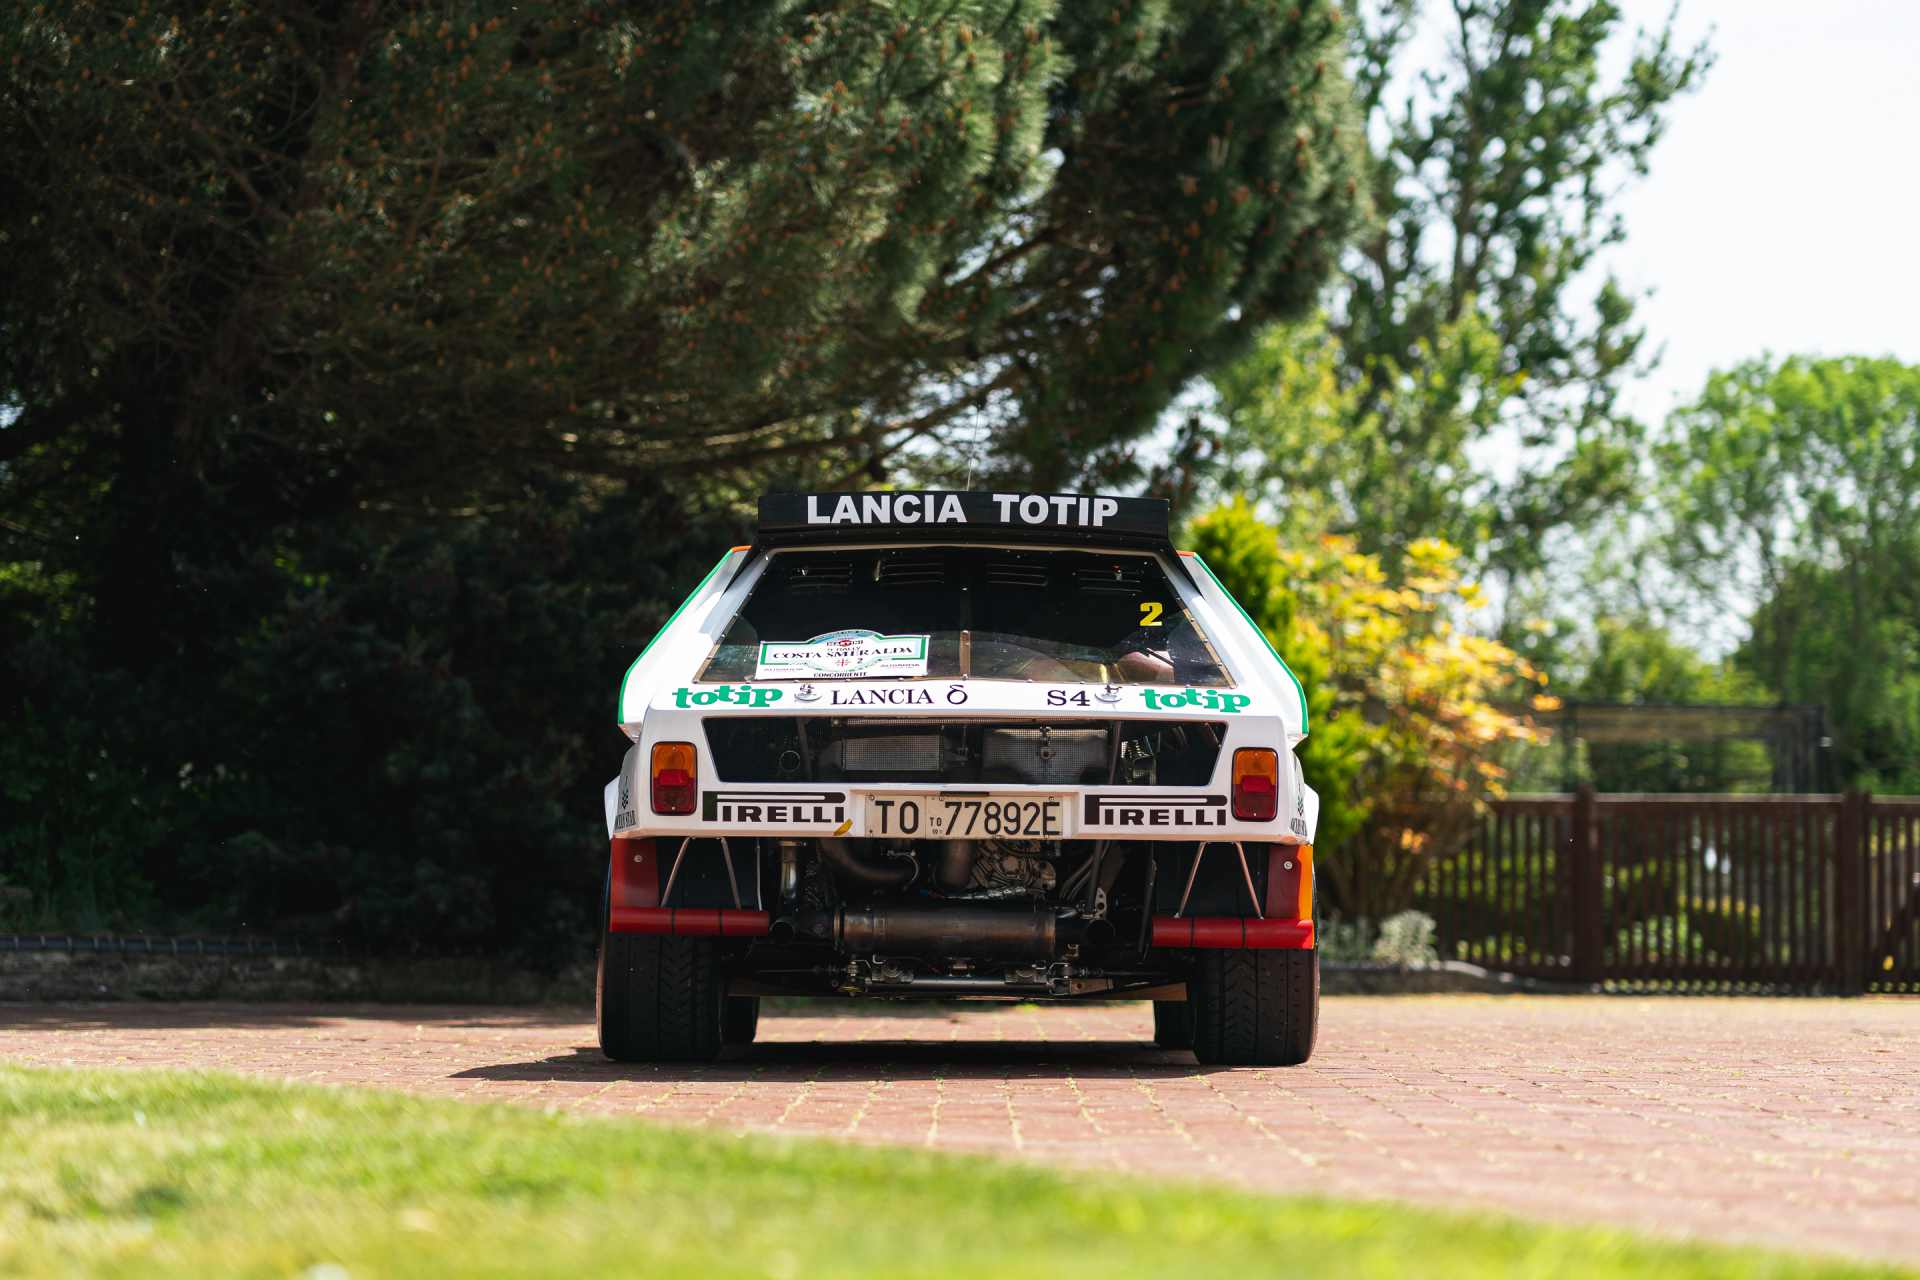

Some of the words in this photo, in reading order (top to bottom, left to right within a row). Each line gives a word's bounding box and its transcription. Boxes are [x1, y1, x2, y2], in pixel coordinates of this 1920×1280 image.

[807, 494, 968, 524] LANCIA
[992, 493, 1119, 526] TOTIP
[1140, 602, 1163, 627] 2
[773, 651, 822, 659] COSTA
[826, 647, 913, 658] SMERALDA
[671, 685, 784, 709] totip
[830, 688, 934, 705] LANCIA
[1047, 689, 1091, 707] S4
[1139, 688, 1251, 713] totip
[702, 791, 846, 823] PIRELLI
[875, 800, 919, 835] TO
[944, 801, 1060, 836] 77892E
[1084, 794, 1228, 826] PIRELLI
